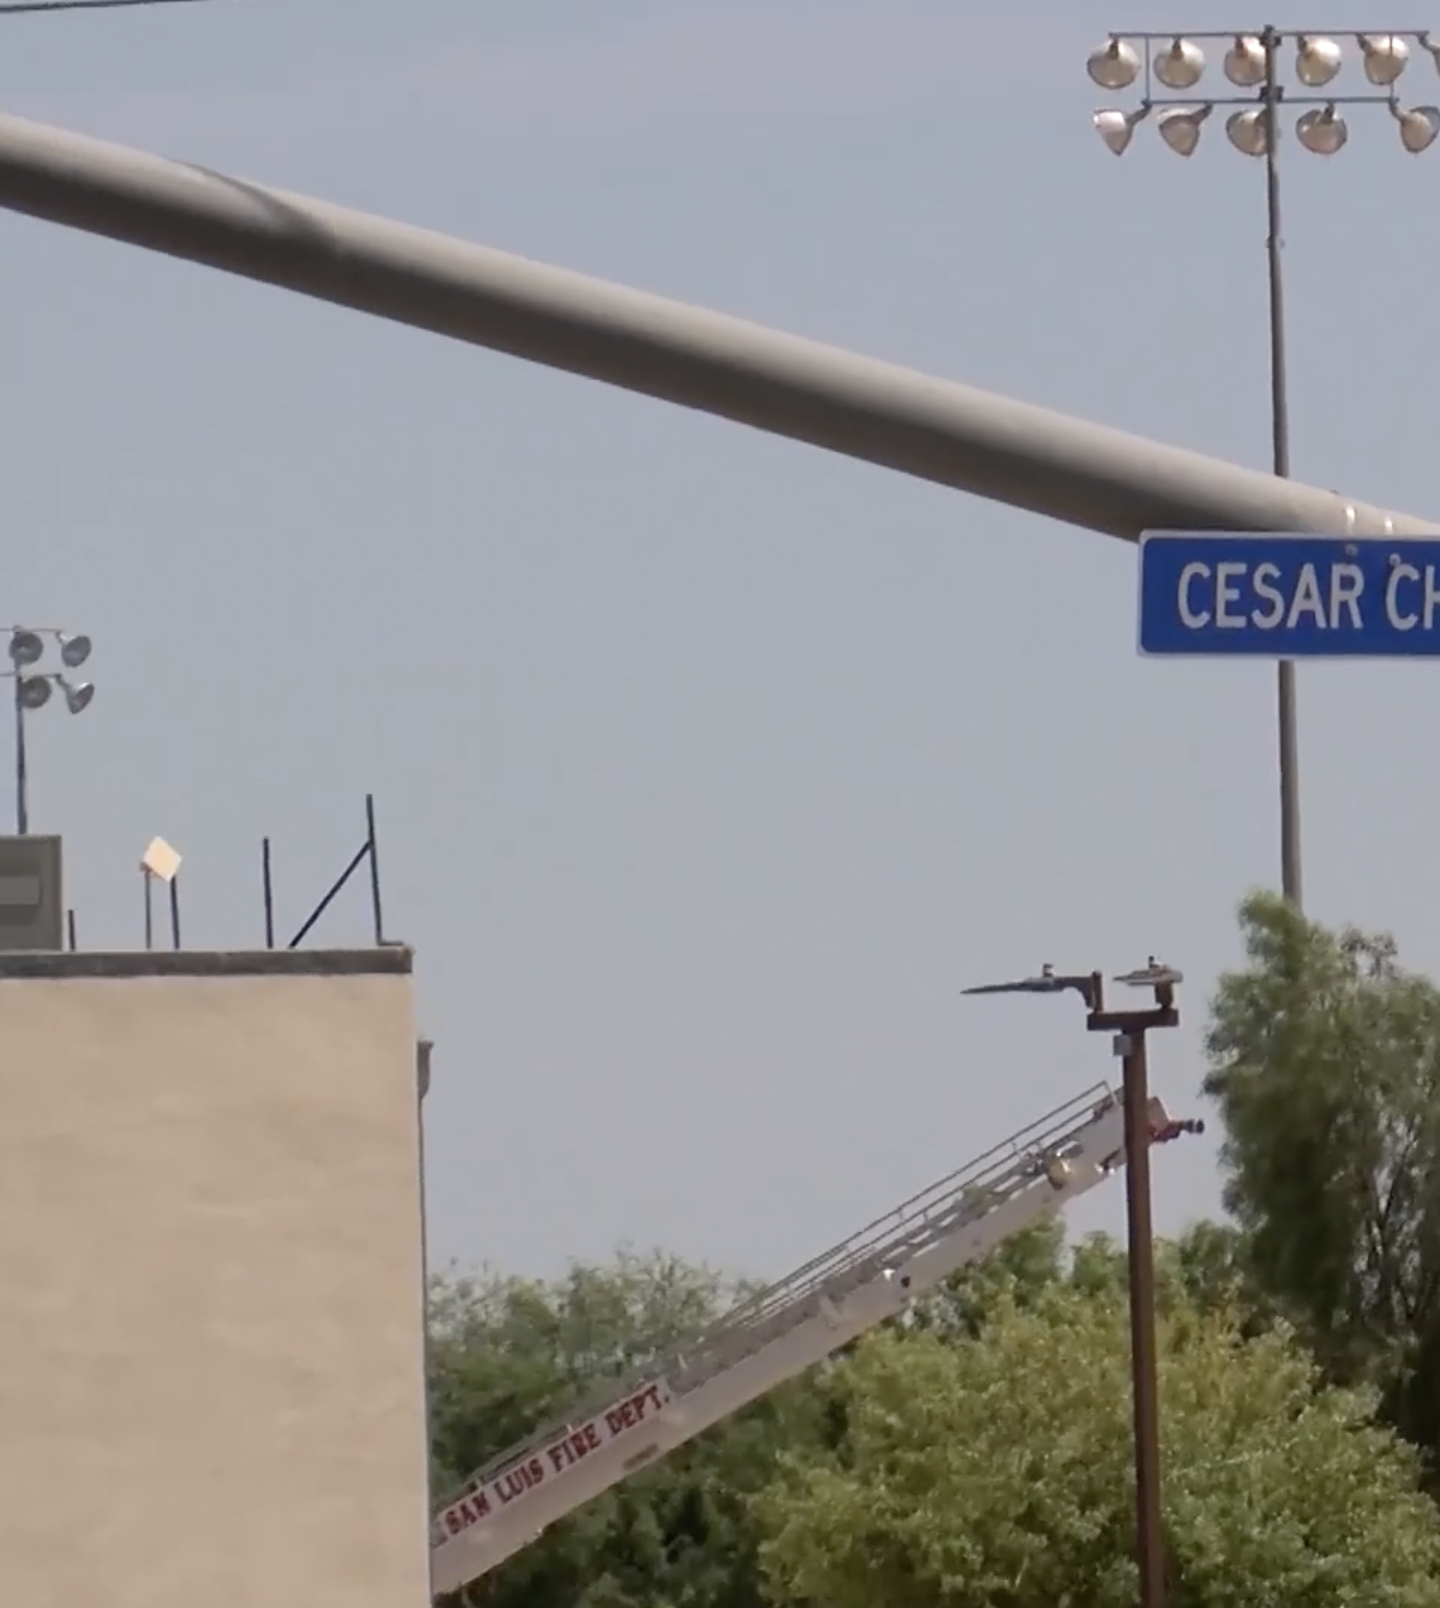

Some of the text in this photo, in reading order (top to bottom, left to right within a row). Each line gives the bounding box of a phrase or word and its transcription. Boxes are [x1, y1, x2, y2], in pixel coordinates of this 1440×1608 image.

[1178, 562, 1364, 629] CESAR
[444, 1384, 670, 1535] SAN LUIS FIRE DEPT.
